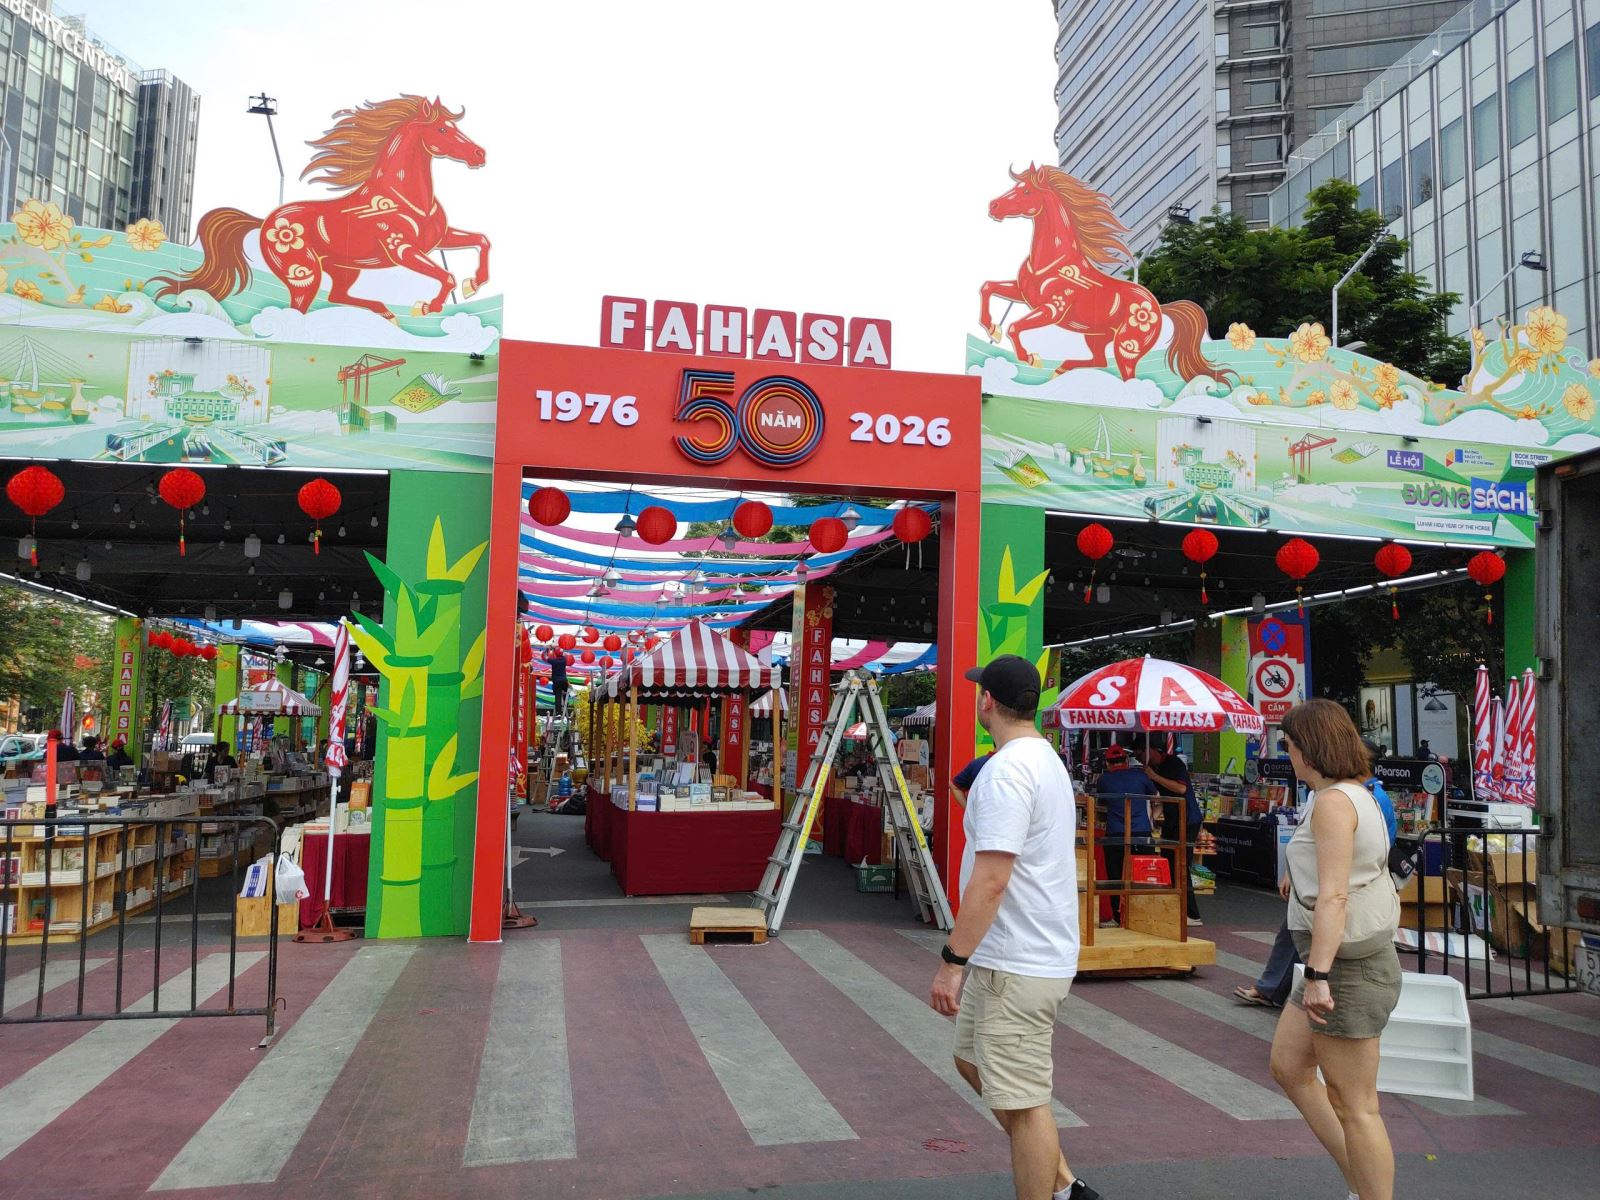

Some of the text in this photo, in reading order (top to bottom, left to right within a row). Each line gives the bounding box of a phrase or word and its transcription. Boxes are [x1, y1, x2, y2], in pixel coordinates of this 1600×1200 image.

[0, 0, 132, 94] BERTY CENTRAL
[610, 301, 889, 365] FAHASA
[535, 389, 639, 426] 1976
[672, 367, 826, 470] 50
[760, 410, 801, 429] NĂM
[849, 412, 951, 447] 2026
[1389, 451, 1420, 468] LỄ HỘI
[1529, 453, 1549, 461] STREET
[1473, 482, 1525, 512] SÁCH
[119, 652, 132, 745] FAHASA
[809, 630, 823, 744] FAHASA
[666, 707, 674, 743] HASA
[730, 693, 740, 743] HASA
[1069, 710, 1126, 725] FAHASA
[1149, 711, 1216, 728] FAHASA
[1232, 714, 1262, 730] FAHASA
[1377, 764, 1411, 778] Pearson
